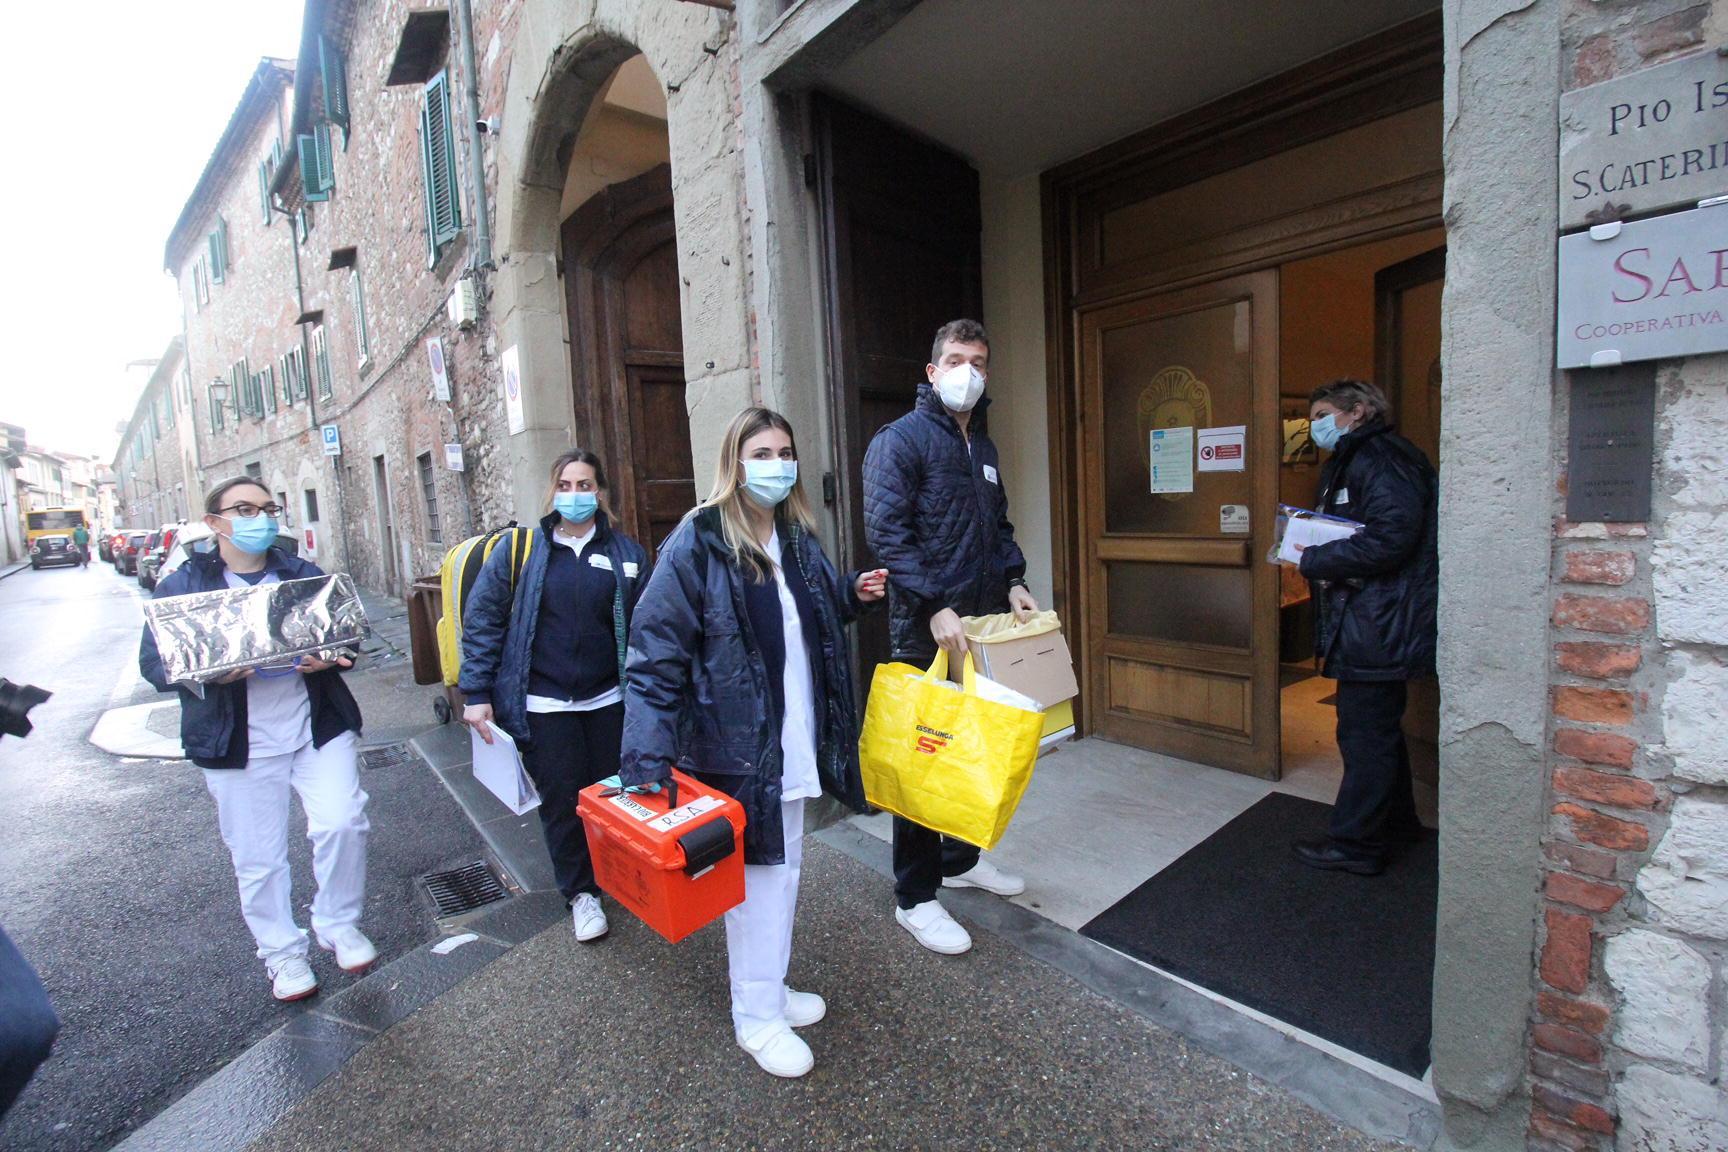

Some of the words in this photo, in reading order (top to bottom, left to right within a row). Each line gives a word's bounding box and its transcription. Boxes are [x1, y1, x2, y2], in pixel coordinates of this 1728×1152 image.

[1608, 99, 1671, 136] PIO
[1575, 310, 1724, 340] COOPERATIVA
[326, 429, 334, 441] P
[915, 724, 954, 741] ESSELUNGA
[661, 806, 703, 826] RSA
